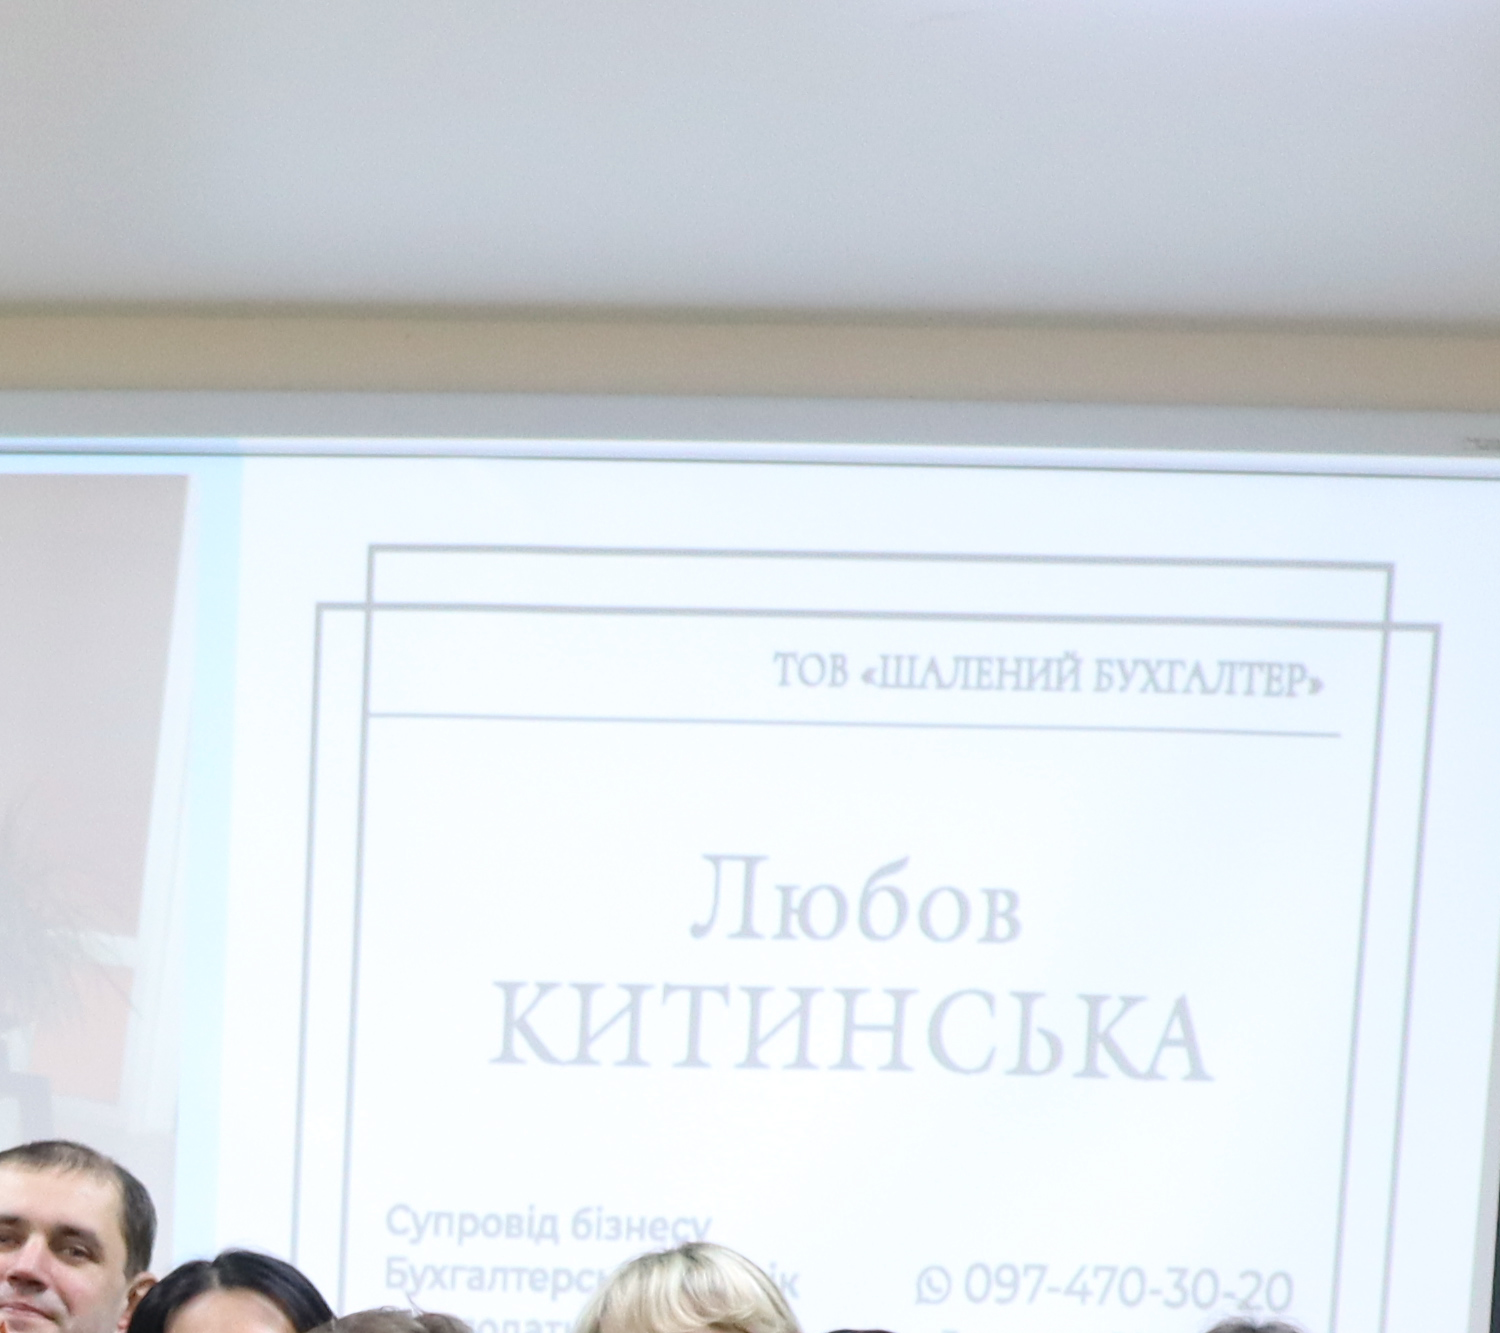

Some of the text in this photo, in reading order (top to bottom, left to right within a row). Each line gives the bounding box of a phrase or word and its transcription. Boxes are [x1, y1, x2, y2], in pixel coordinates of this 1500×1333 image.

[772, 650, 1325, 698] ТОВ «ШАЛЕНИЙ БУХГАЛТЕР»
[688, 852, 1024, 945] Любов
[487, 978, 1216, 1083] КИТИНСЬКА
[385, 1203, 713, 1246] Супровід бізнесу
[963, 1262, 1295, 1312] 097-470-30-20
